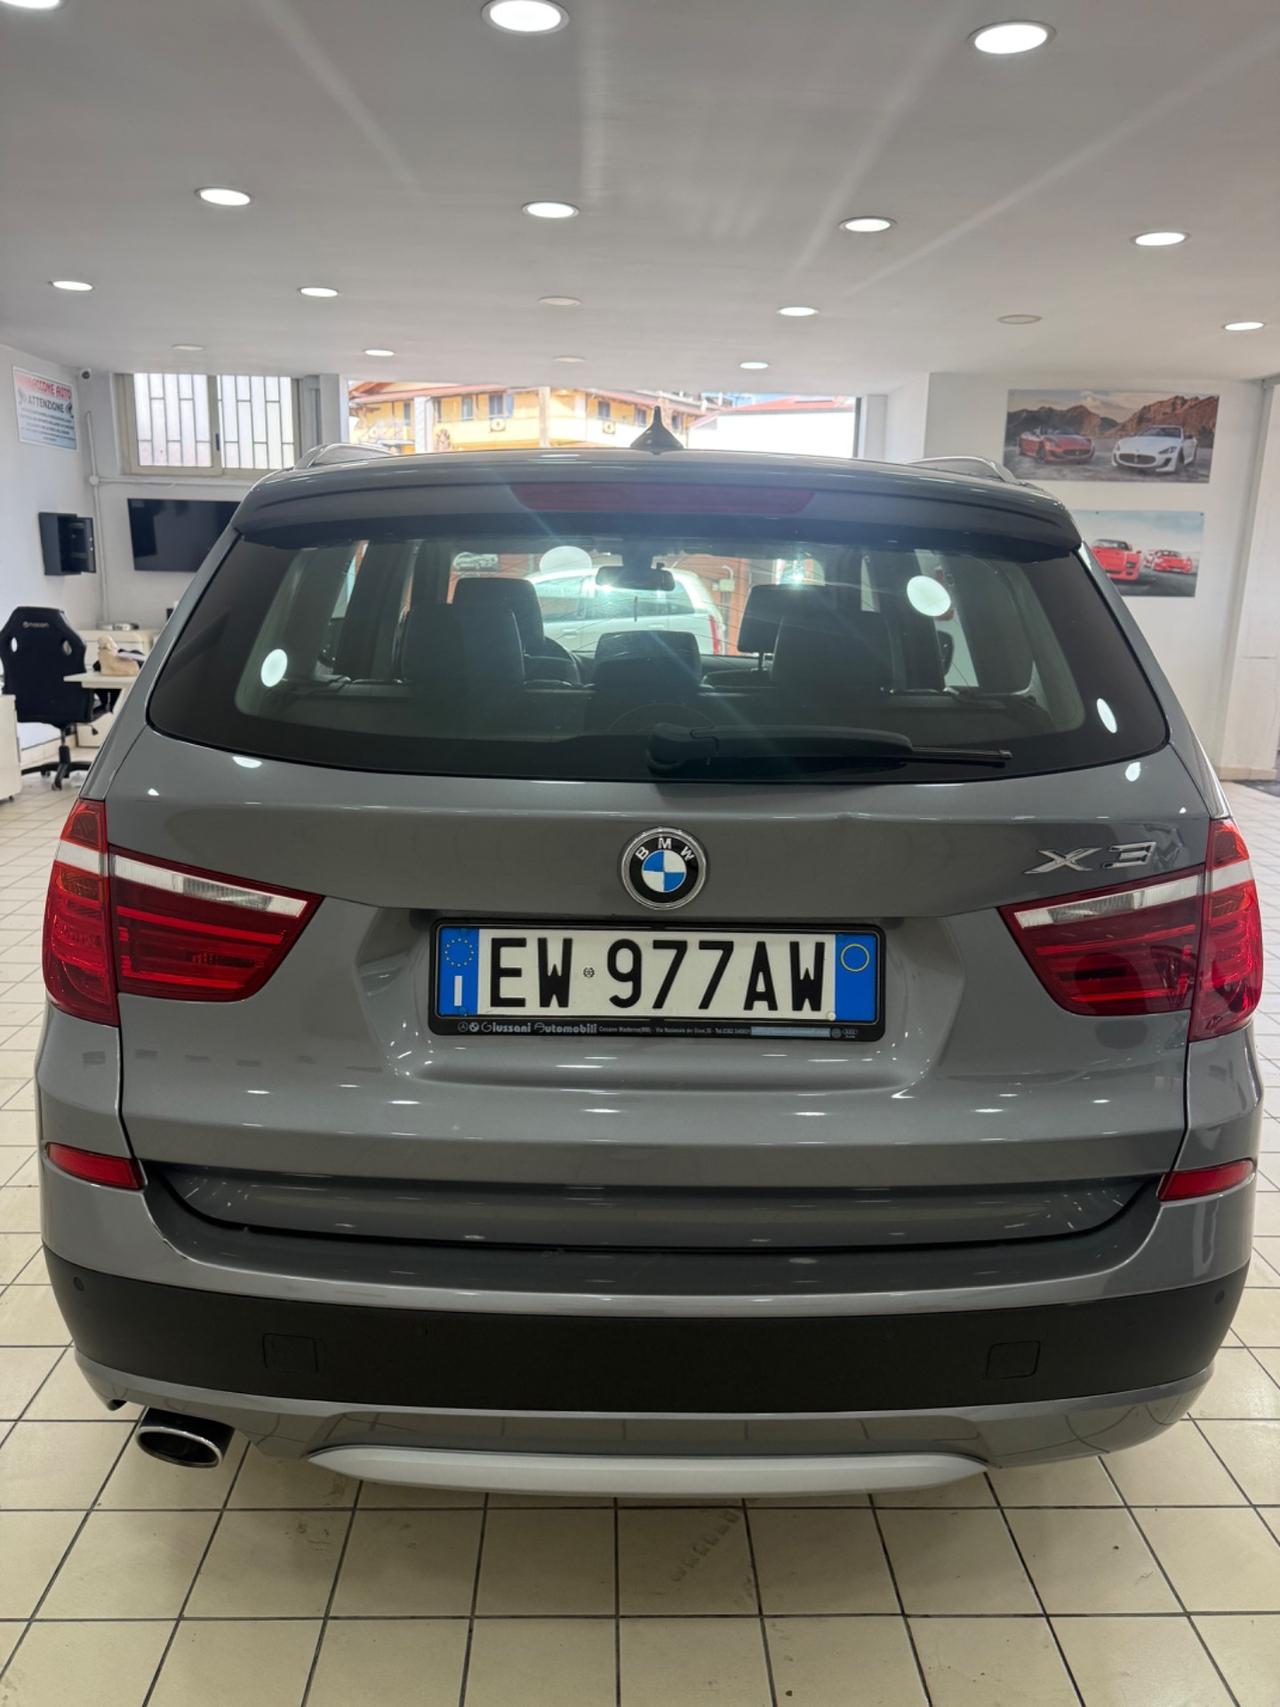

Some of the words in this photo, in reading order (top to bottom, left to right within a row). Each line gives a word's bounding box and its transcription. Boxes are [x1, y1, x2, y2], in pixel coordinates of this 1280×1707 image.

[635, 837, 695, 861] BMW
[1024, 842, 1157, 874] X3
[490, 937, 573, 1008] EW
[607, 938, 825, 1012] 977AW
[534, 1022, 598, 1034] Automobili
